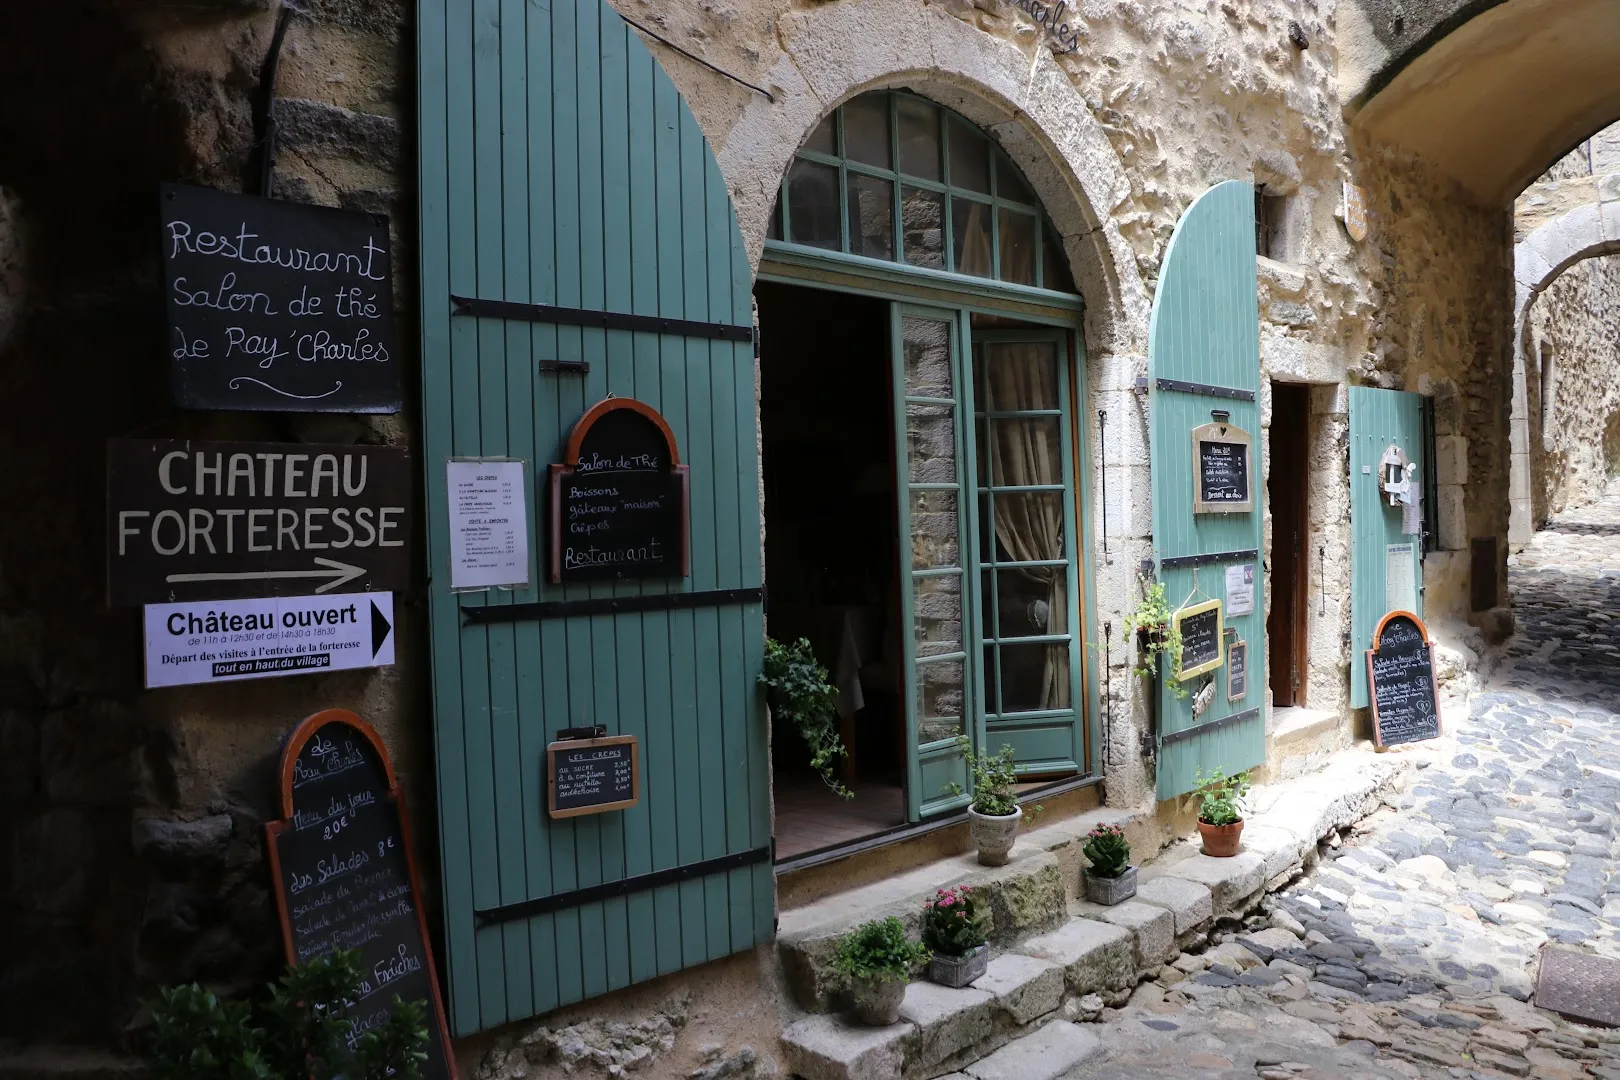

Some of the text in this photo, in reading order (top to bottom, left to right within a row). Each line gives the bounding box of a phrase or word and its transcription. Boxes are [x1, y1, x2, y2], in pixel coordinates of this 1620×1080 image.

[167, 220, 386, 281] Restaurant
[173, 272, 382, 319] Salon de thé
[173, 326, 210, 360] Le
[225, 327, 289, 369] Ray
[577, 452, 614, 472] Salon
[615, 455, 632, 469] de
[158, 450, 368, 498] CHATEAU
[568, 486, 620, 498] Boissons
[569, 501, 617, 519] gâteaux
[118, 507, 405, 557] FORTERESSE
[570, 520, 610, 536] Crêpes
[166, 603, 357, 636] Château ouvert
[187, 627, 336, 646] de 11h à 12h30 et de 14h30 à 18h30
[161, 653, 198, 666] Départ
[199, 651, 216, 661] des
[218, 648, 248, 660] visites
[250, 648, 256, 656] à
[296, 644, 307, 653] de
[308, 643, 317, 652] la
[319, 639, 361, 652] forteresse
[214, 655, 329, 674] tout en haut du village
[311, 734, 338, 755] Le
[592, 750, 621, 759] CREPES
[574, 764, 594, 772] SUCRE
[576, 771, 606, 781] confiture
[574, 779, 602, 788] nutella
[293, 790, 376, 828] Menu du jour
[323, 816, 349, 840] 20€
[316, 850, 370, 884] Salades
[336, 884, 352, 899] du
